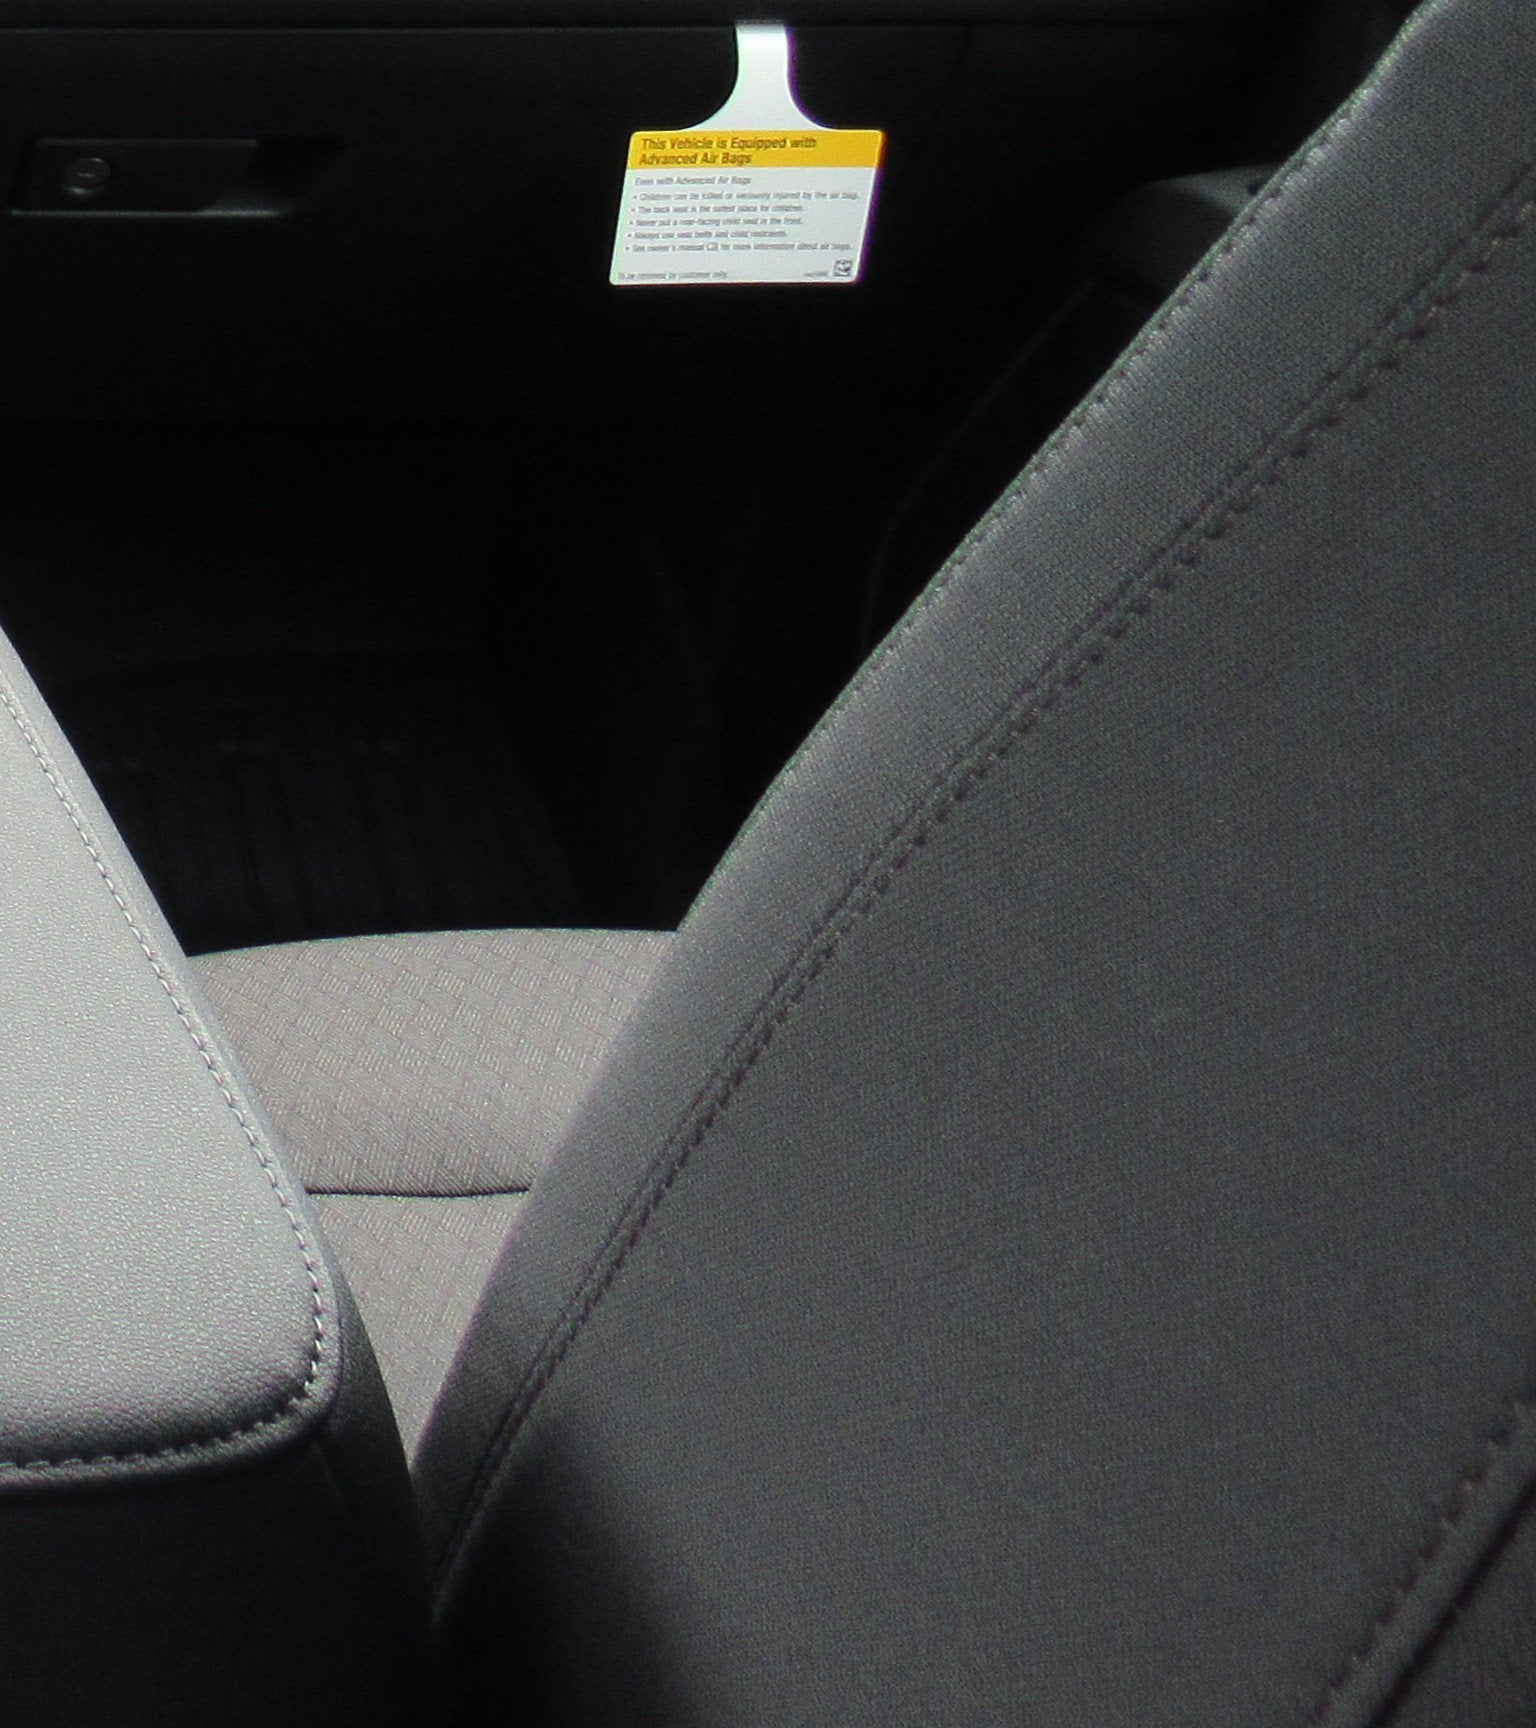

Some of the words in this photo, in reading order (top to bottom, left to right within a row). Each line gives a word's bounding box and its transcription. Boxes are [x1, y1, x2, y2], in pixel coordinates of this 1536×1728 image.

[642, 138, 666, 149] This
[670, 138, 714, 149] Vehicle
[730, 137, 786, 151] Equipped
[790, 137, 817, 148] with
[639, 153, 698, 165] Advanced
[721, 153, 753, 167] Bags
